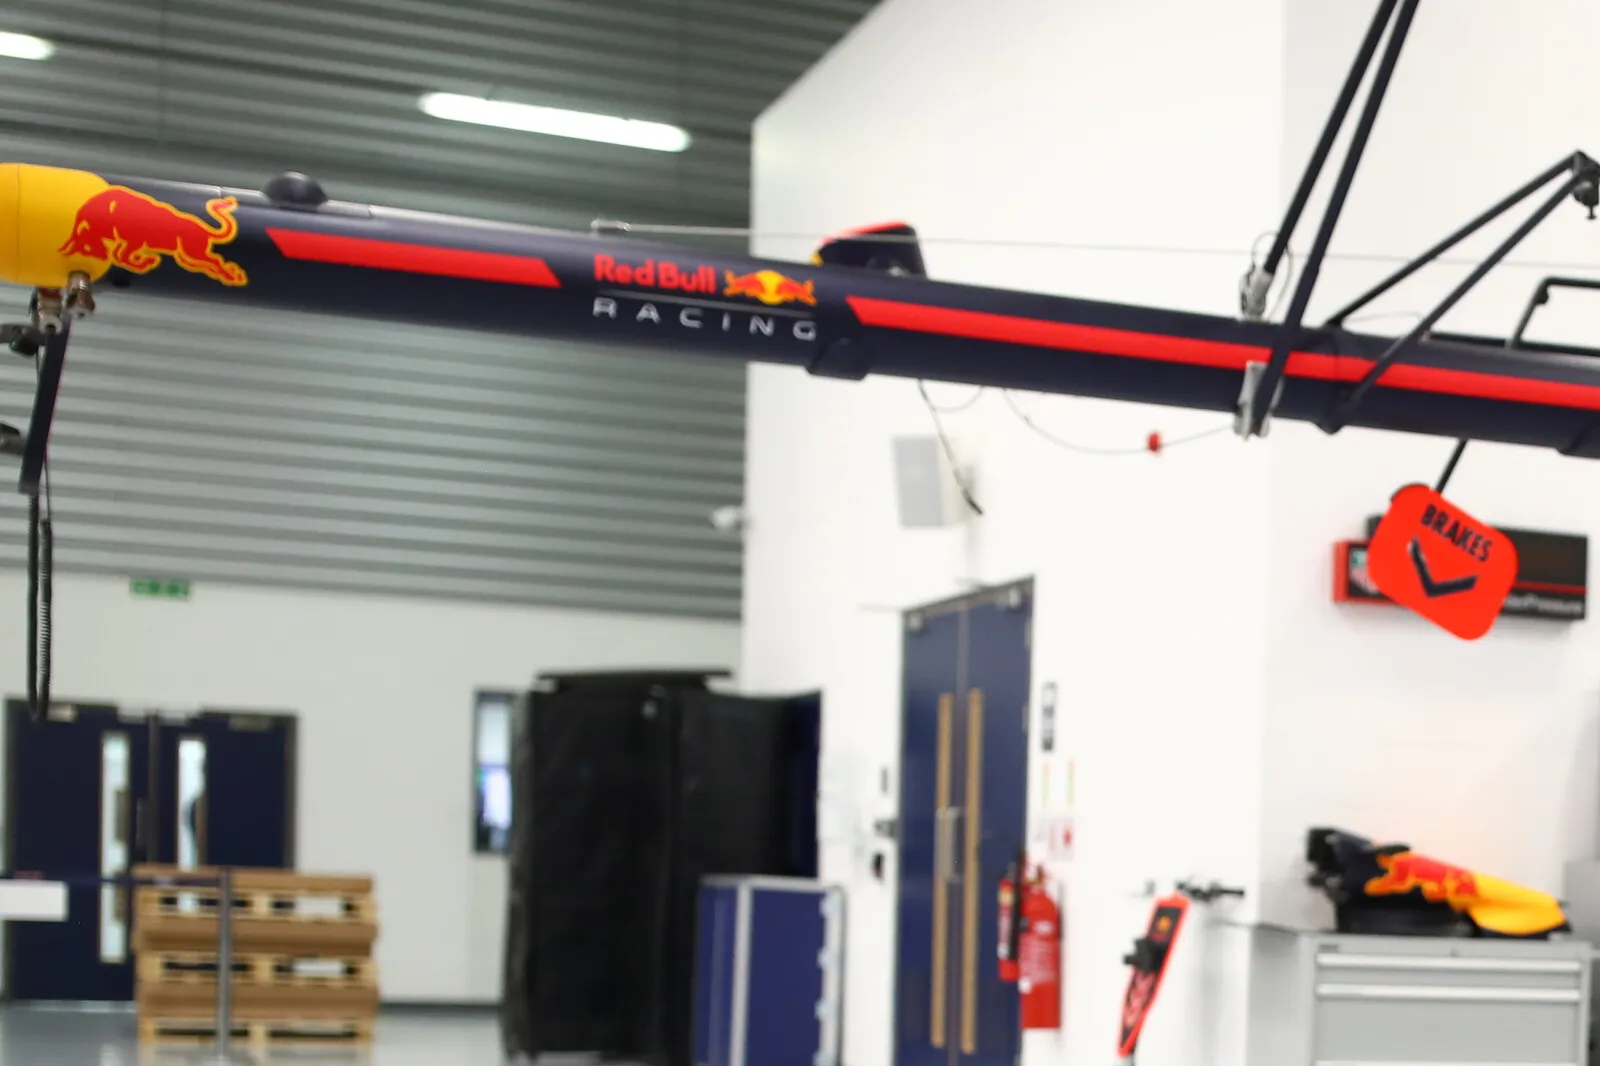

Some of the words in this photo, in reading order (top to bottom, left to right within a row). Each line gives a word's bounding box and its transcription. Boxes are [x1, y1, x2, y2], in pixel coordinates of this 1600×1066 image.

[594, 254, 655, 287] Red
[657, 261, 716, 294] Bull
[593, 297, 817, 341] RACING
[1420, 503, 1494, 562] BRAKES
